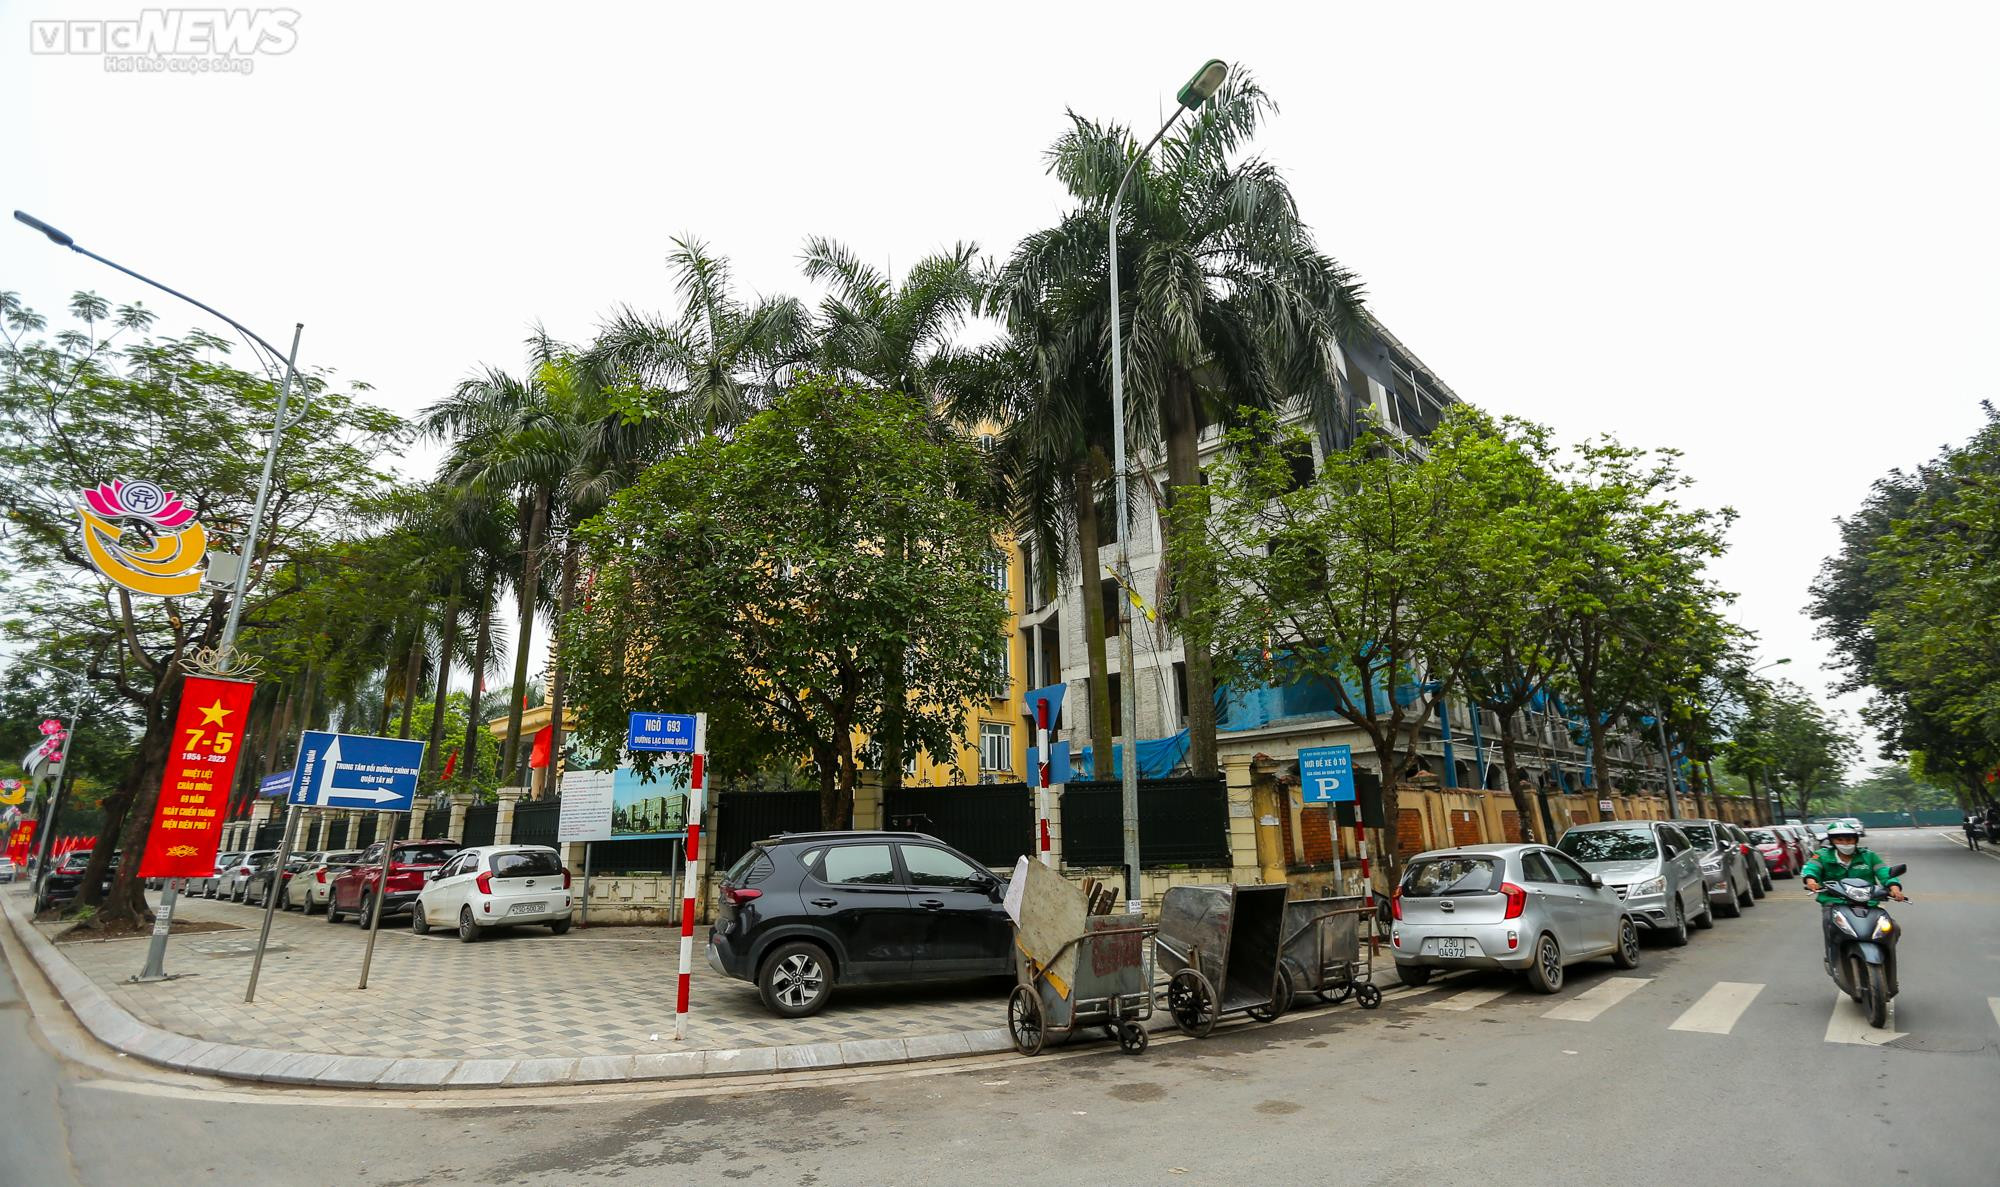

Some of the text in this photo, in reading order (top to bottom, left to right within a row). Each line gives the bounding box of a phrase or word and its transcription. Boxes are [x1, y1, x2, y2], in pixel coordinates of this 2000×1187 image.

[645, 717, 680, 732] NGÕ 693
[185, 729, 234, 754] 7-5
[1314, 778, 1340, 799] P
